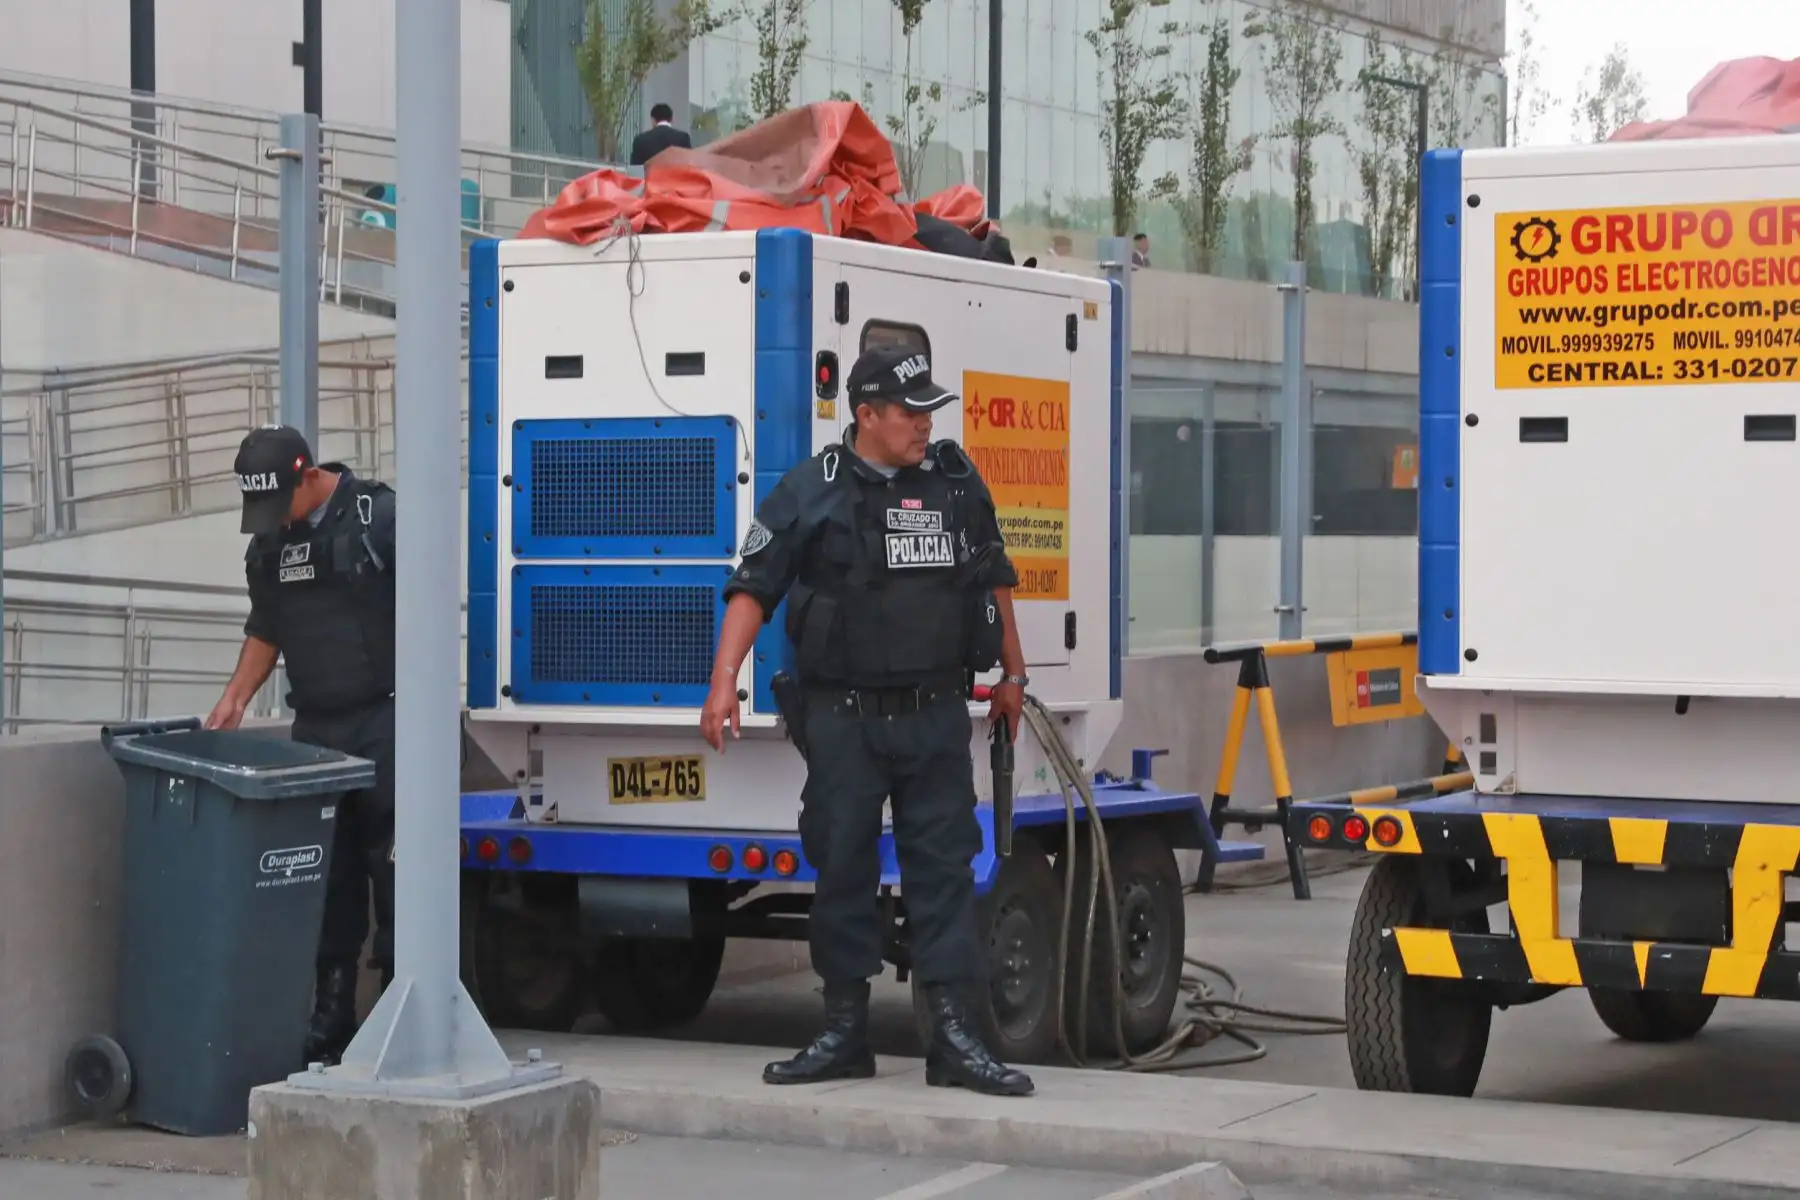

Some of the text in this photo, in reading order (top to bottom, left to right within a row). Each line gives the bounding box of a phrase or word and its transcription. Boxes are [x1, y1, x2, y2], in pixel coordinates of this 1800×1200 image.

[1571, 208, 1733, 255] GRUPO
[1507, 264, 1609, 297] GRUPOS
[1519, 297, 1800, 328] www.grupodr.com.pe
[1673, 329, 1730, 350] MOVIL.
[1527, 357, 1798, 382] CENTRAL: 331-0207
[1021, 399, 1035, 430] &
[1038, 400, 1066, 431] CIA
[889, 535, 951, 563] POLICIA
[612, 759, 701, 798] D4L-765
[268, 850, 316, 868] Duraplast
